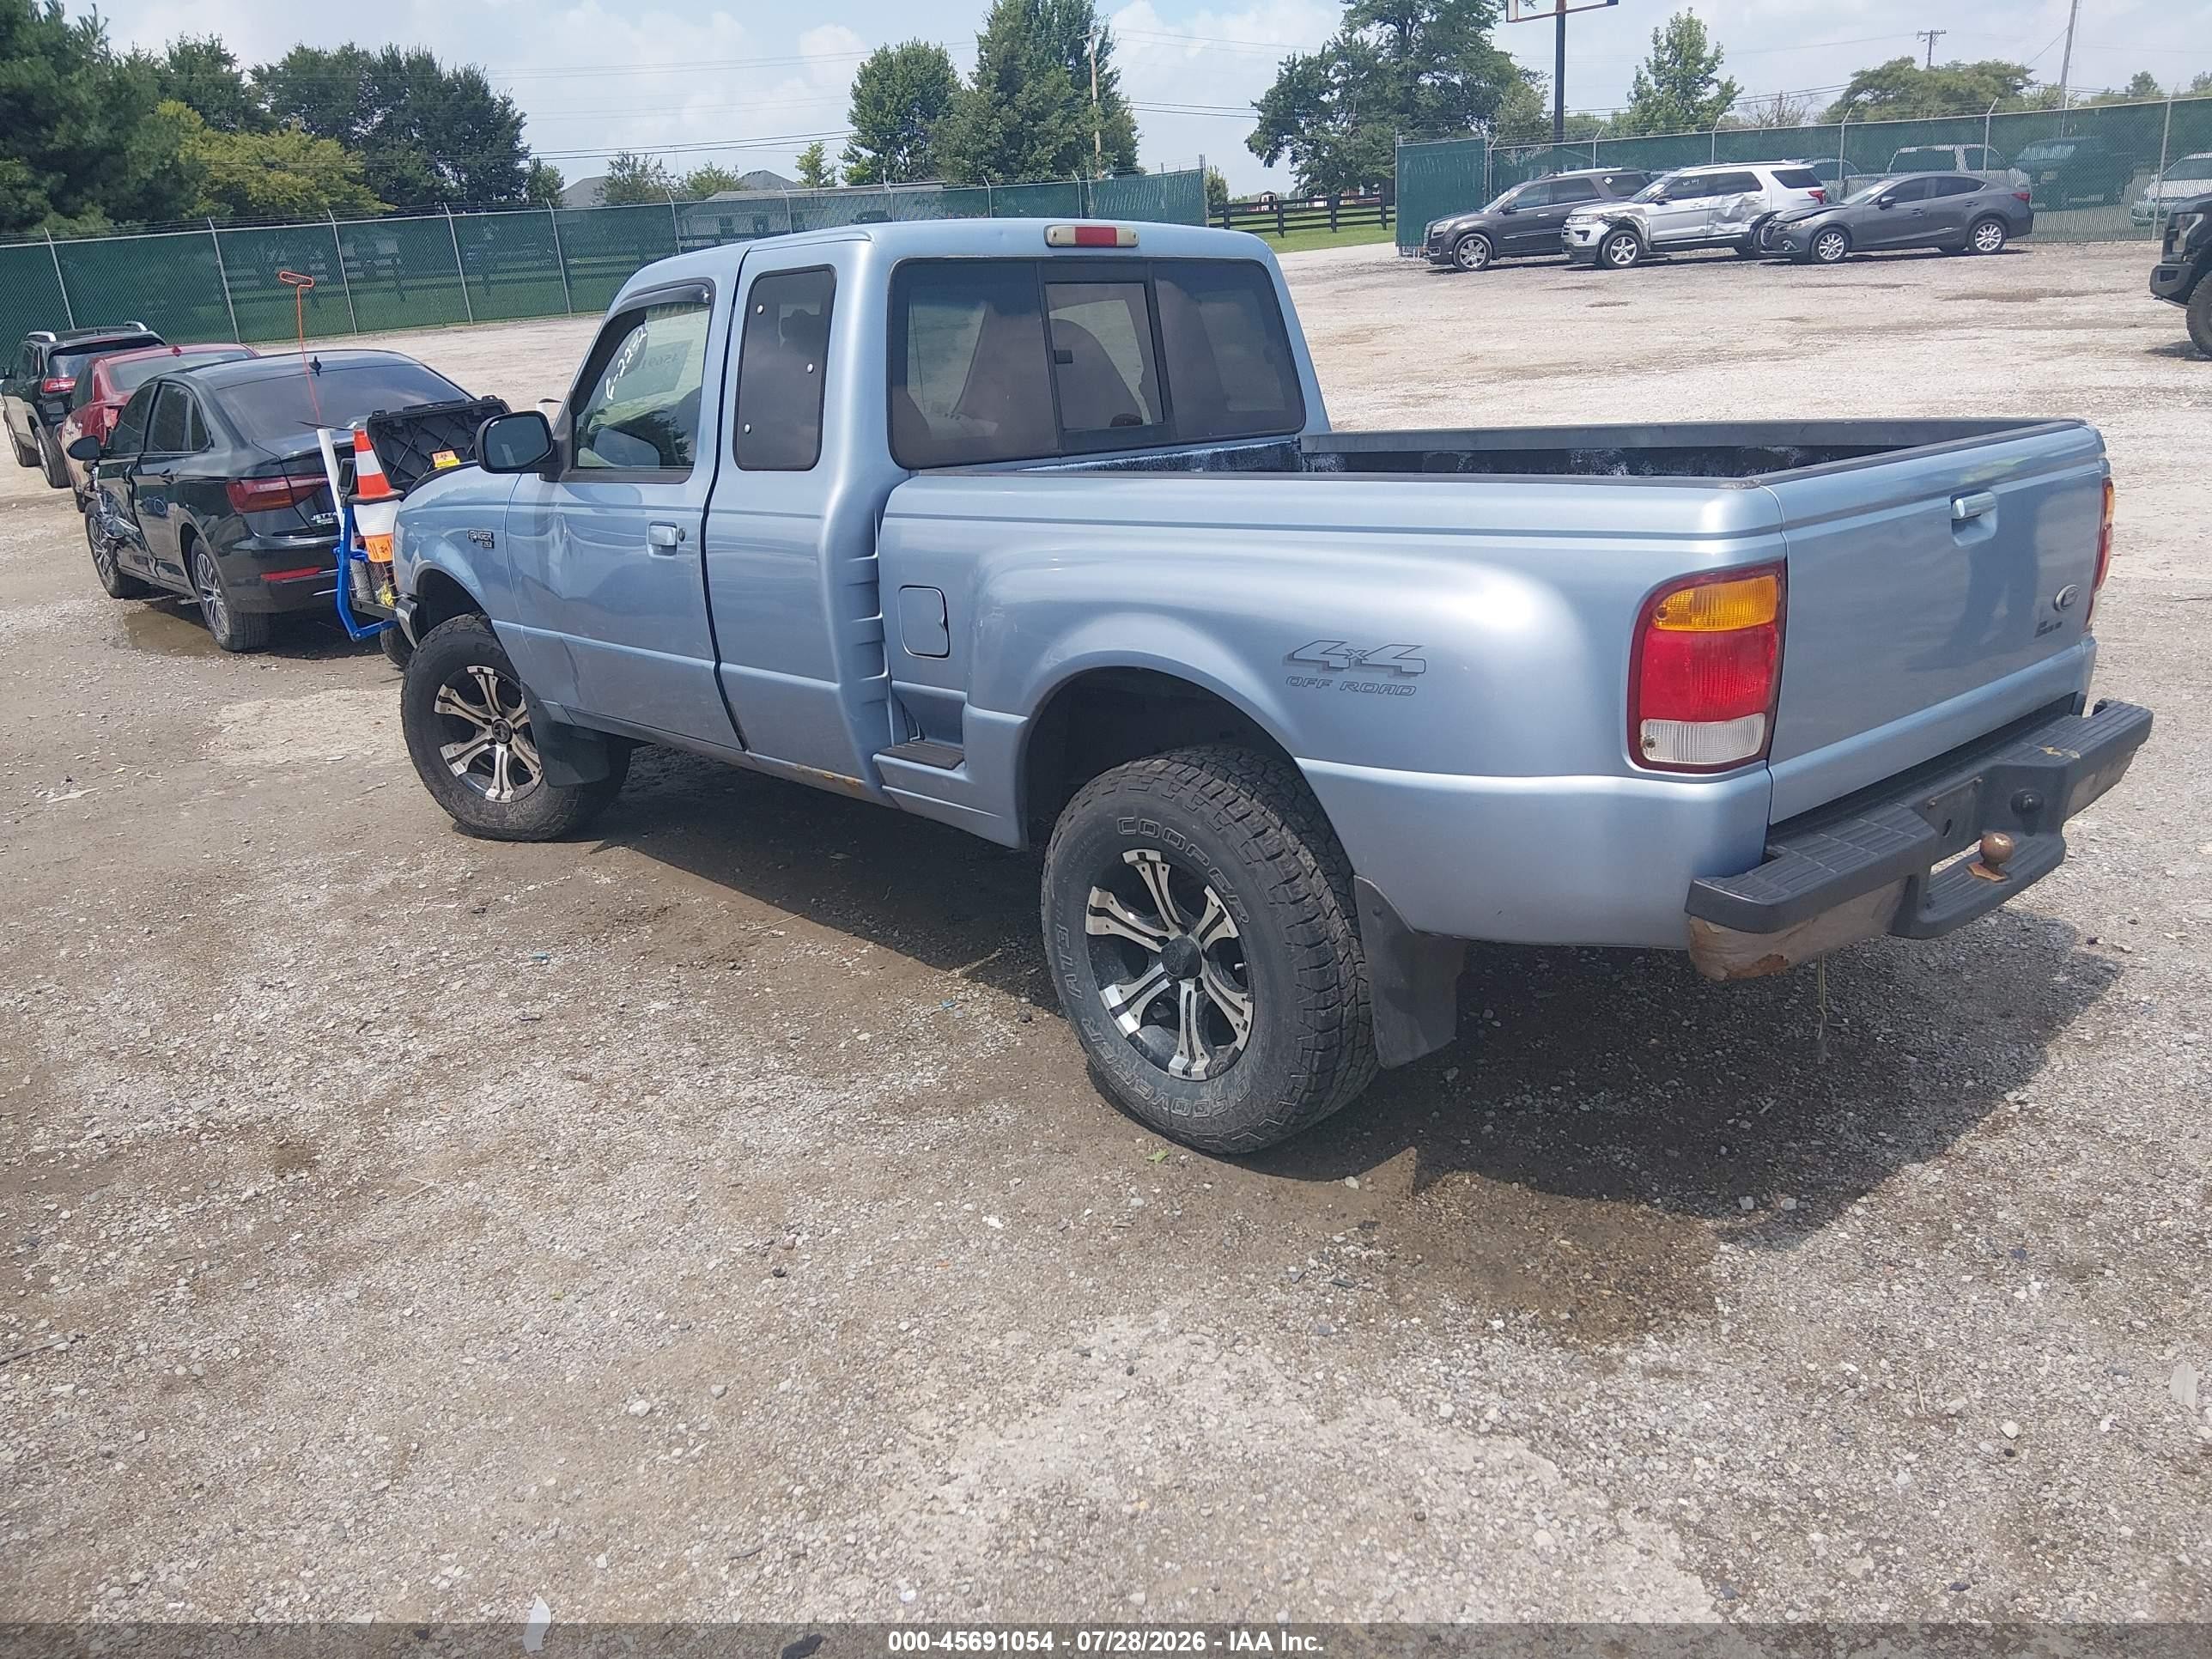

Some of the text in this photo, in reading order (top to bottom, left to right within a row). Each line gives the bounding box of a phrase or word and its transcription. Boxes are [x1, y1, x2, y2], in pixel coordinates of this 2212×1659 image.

[1285, 675, 1417, 696] OFF ROAD
[1117, 817, 1249, 925] COOPER
[1080, 1017, 1251, 1119] DISCOVERER
